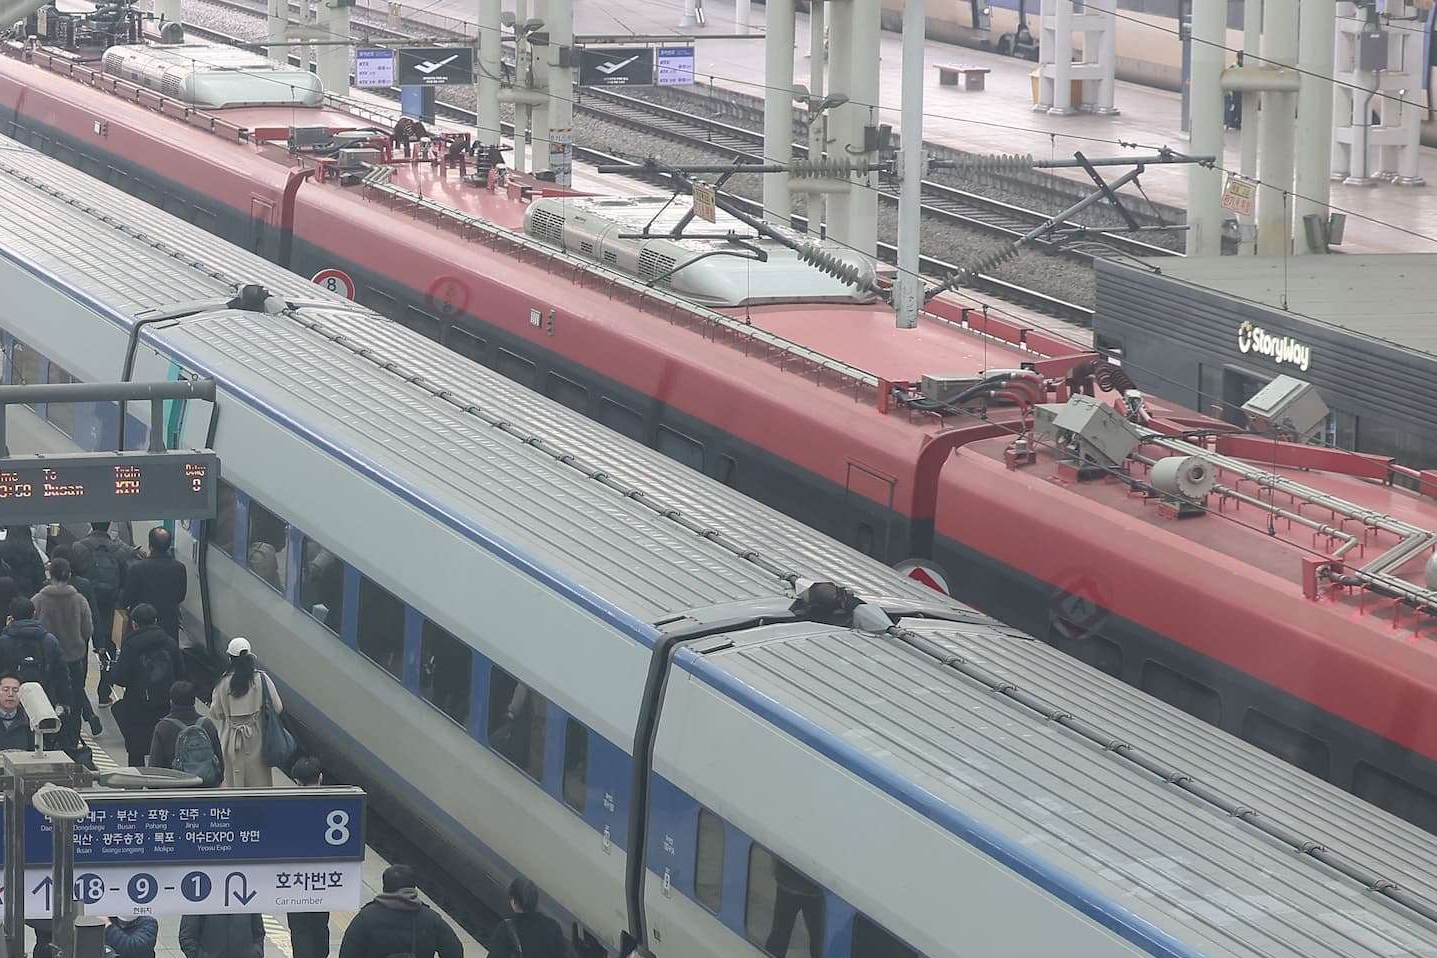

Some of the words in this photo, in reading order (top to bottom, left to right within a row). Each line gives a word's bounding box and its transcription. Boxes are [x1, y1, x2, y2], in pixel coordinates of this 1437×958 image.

[1251, 327, 1310, 372] StoryWay
[117, 809, 138, 822] 부산
[148, 808, 169, 821] 포항
[179, 808, 200, 820] 진주
[210, 807, 231, 820] 마산
[102, 832, 144, 845] 광주송정
[154, 831, 175, 844] 목포
[185, 831, 234, 843] 여수EXPO
[240, 830, 260, 842] 방면
[324, 809, 350, 846] 8
[74, 879, 103, 900] 18
[135, 878, 150, 899] 9
[190, 876, 201, 897] 1
[275, 870, 343, 891] 호차번호
[275, 897, 290, 905] Car
[291, 896, 323, 905] number
